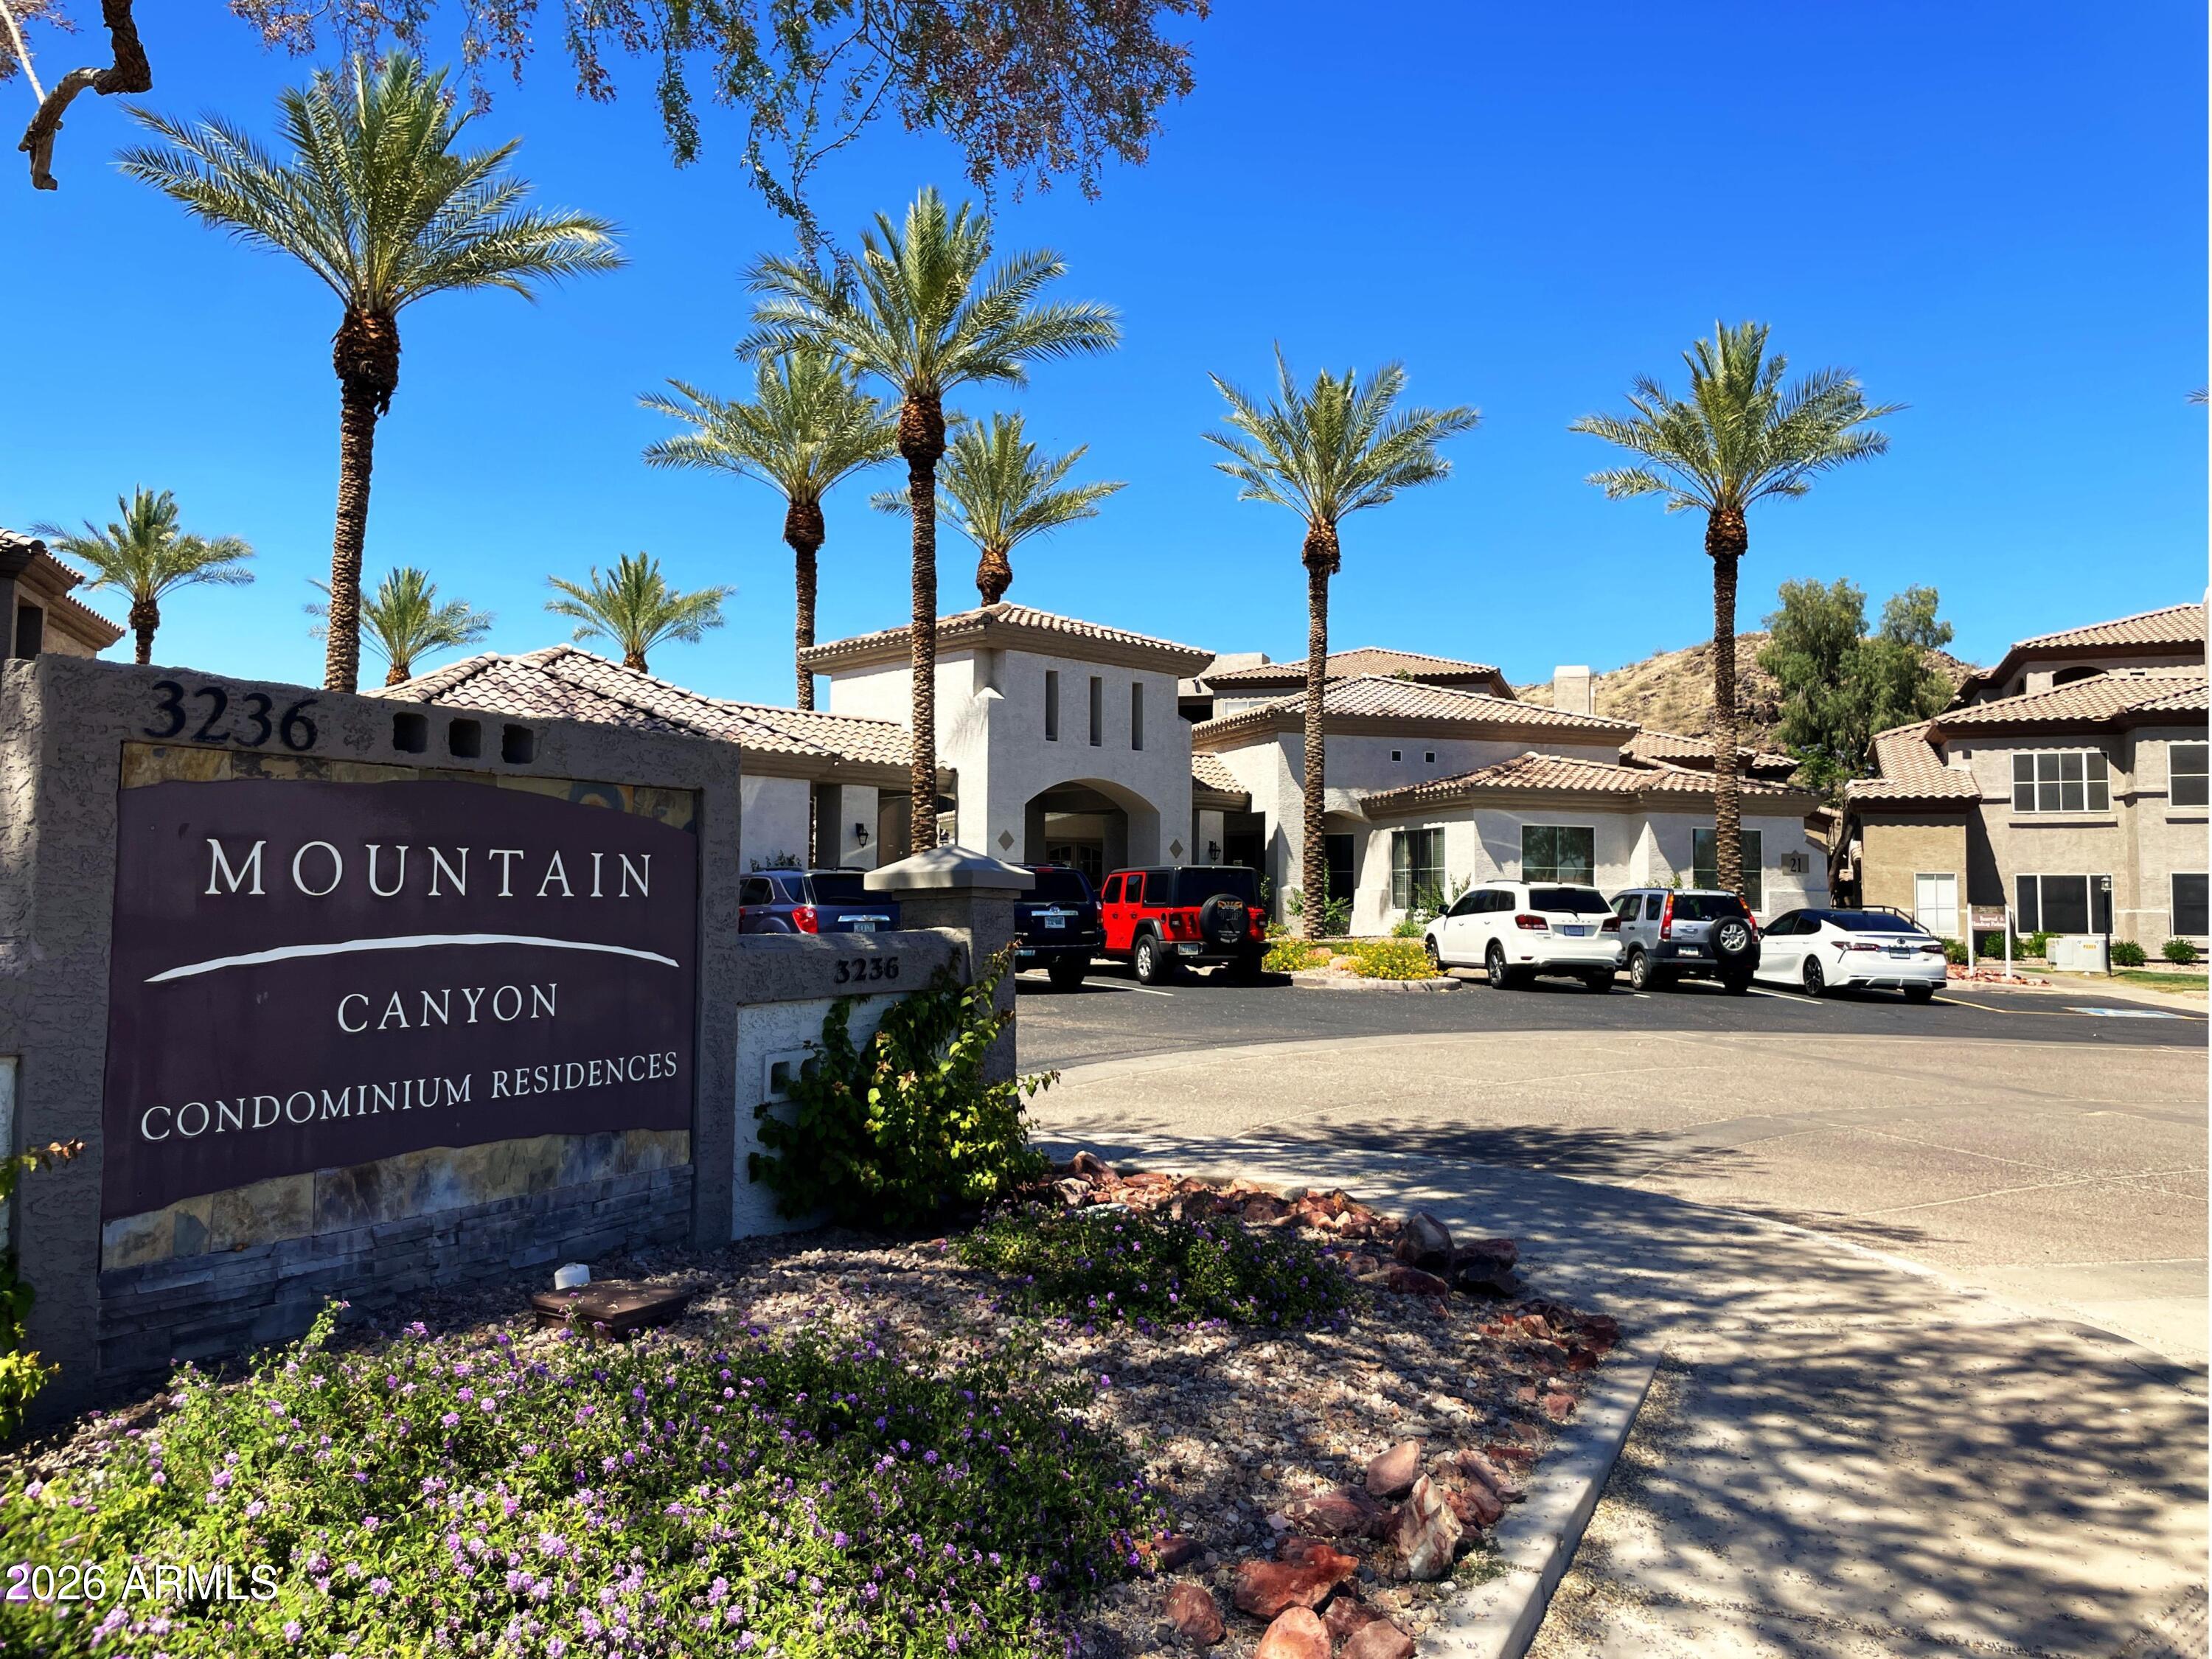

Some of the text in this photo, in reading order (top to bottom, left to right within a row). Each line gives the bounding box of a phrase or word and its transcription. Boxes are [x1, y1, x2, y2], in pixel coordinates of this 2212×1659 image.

[144, 680, 319, 751] 3236
[204, 838, 651, 897] MOUNTAIN
[1790, 858, 1801, 872] 21
[834, 956, 899, 984] 3236
[338, 983, 558, 1033] CANYON
[141, 1051, 677, 1141] CONDOMINIUM RESIDENCES
